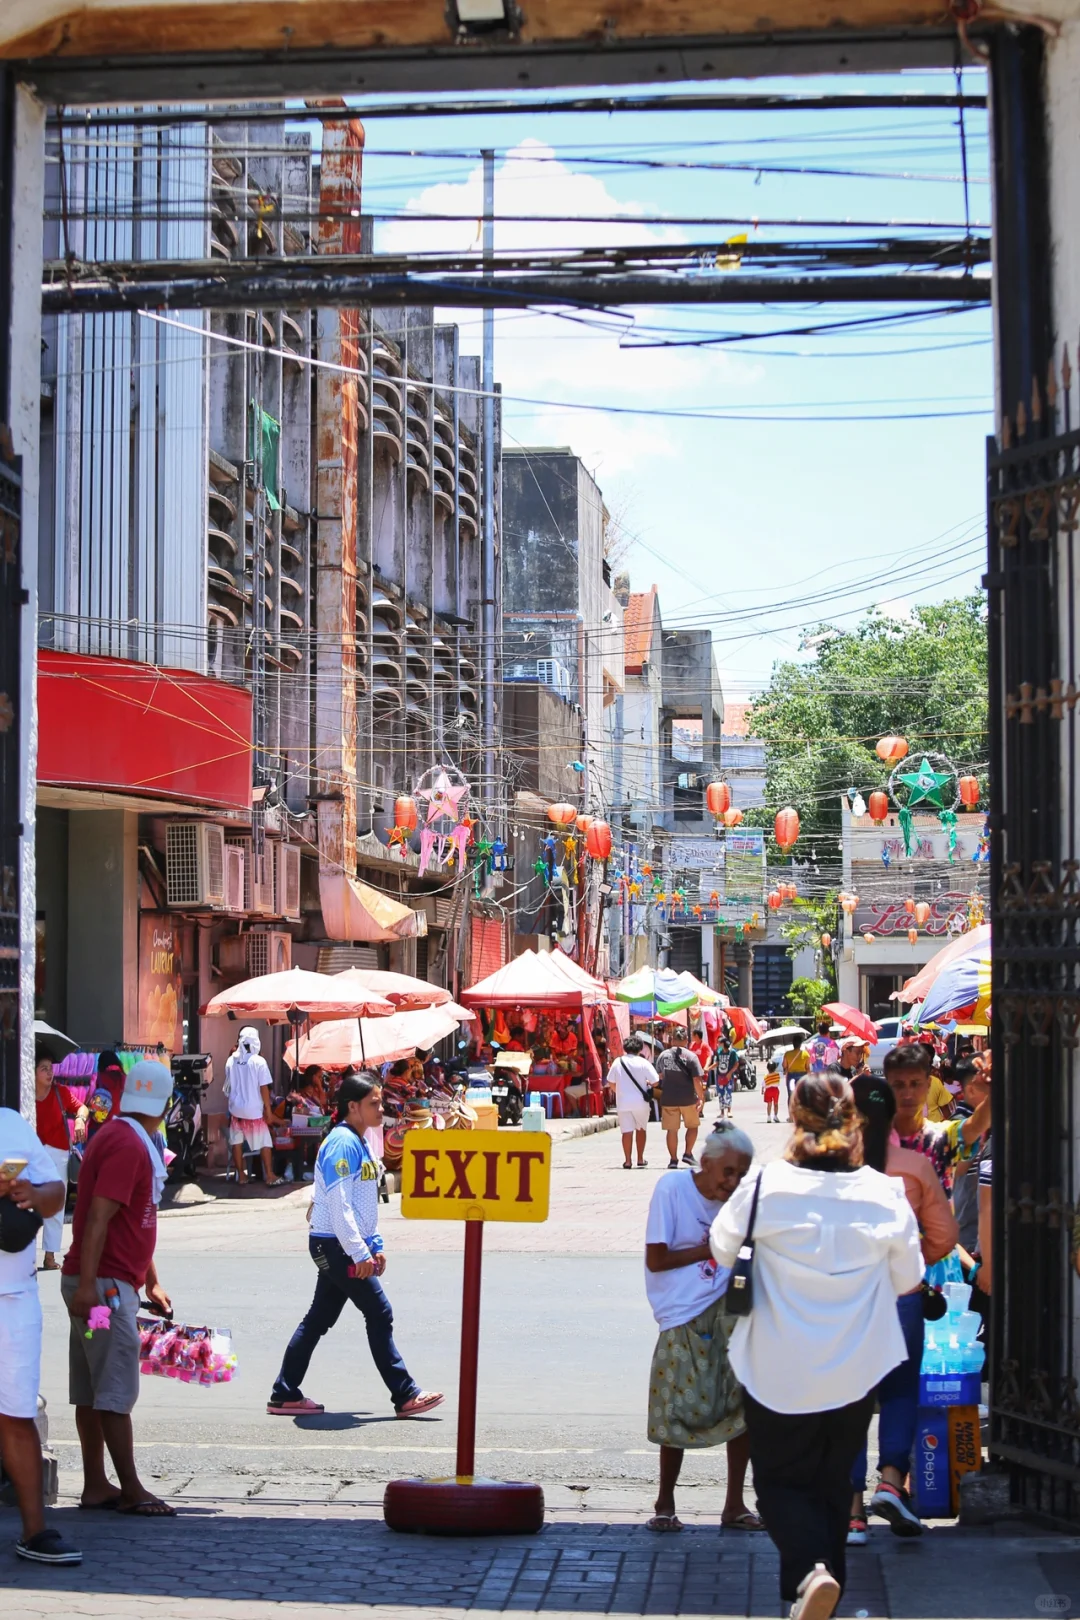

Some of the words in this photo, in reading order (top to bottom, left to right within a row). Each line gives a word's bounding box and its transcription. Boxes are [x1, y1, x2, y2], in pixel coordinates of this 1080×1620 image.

[409, 1150, 544, 1202] EXIT
[934, 1393, 960, 1402] pepsi
[967, 1422, 975, 1466] CROWN
[923, 1452, 937, 1490] pepsi
